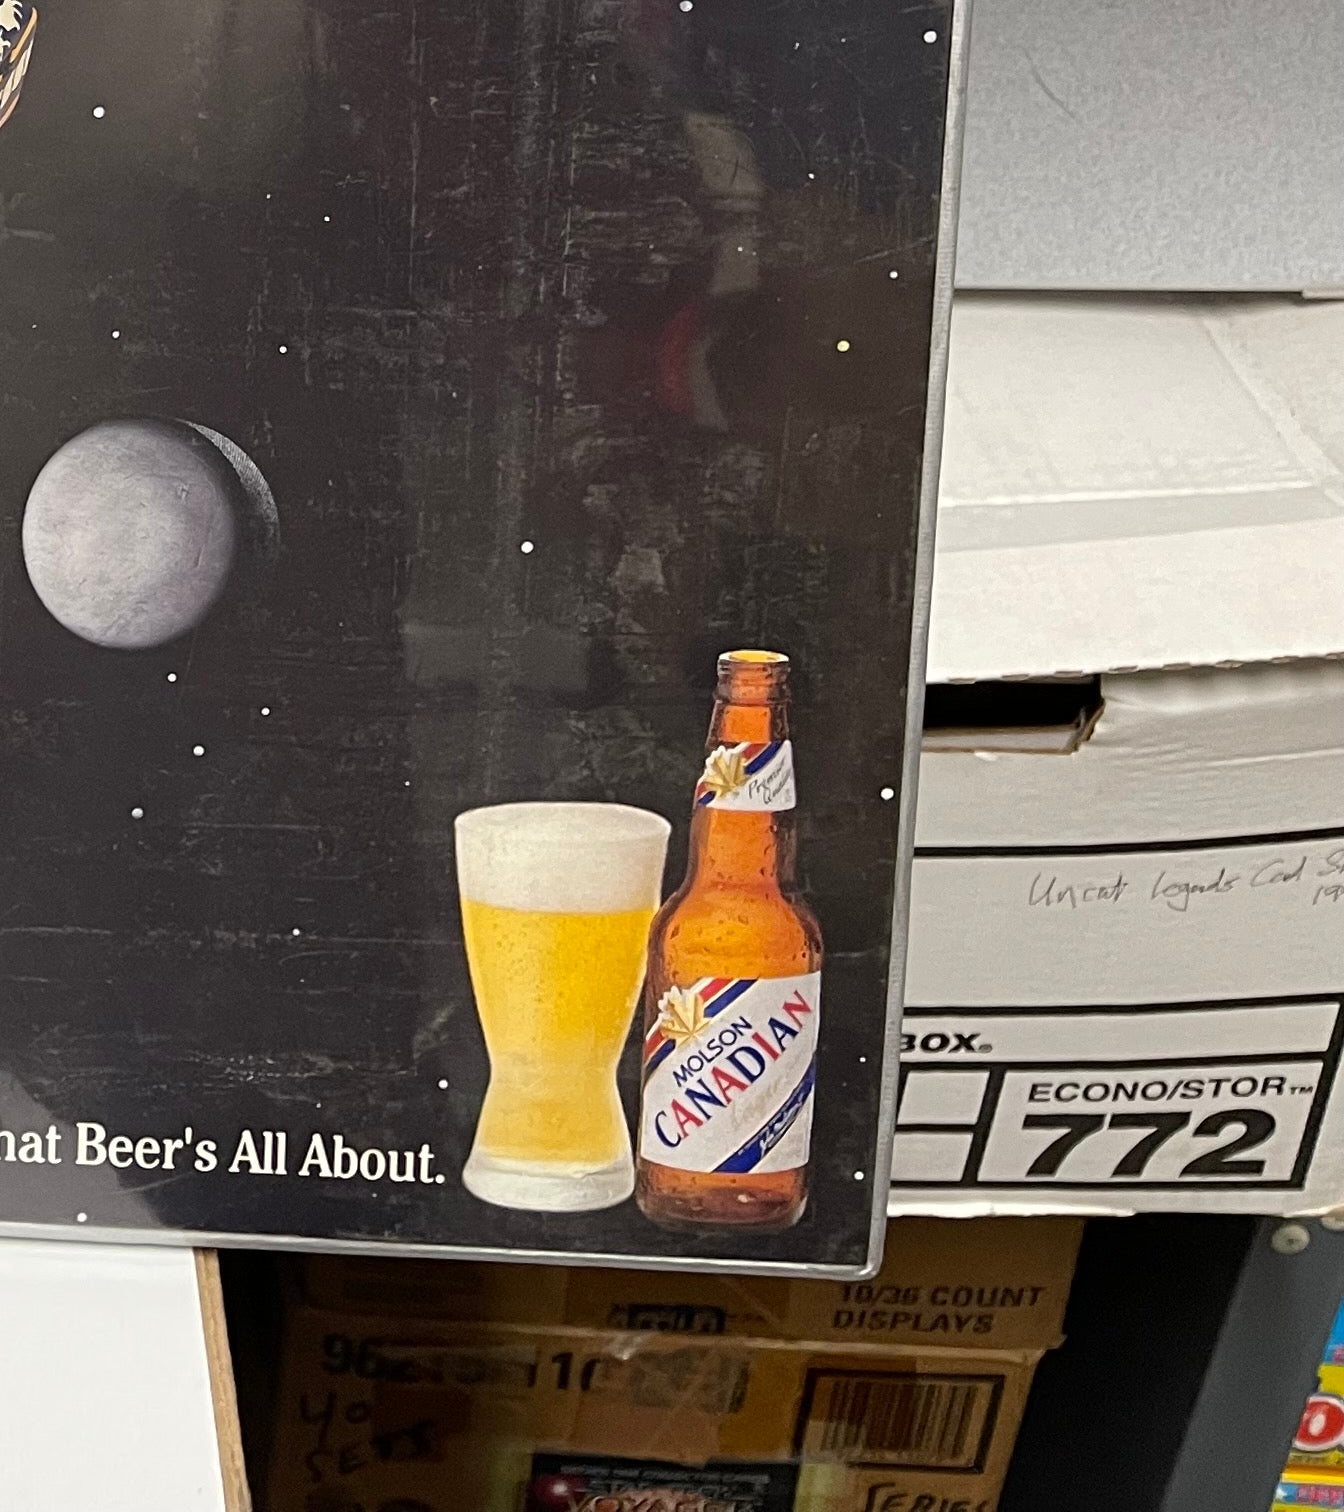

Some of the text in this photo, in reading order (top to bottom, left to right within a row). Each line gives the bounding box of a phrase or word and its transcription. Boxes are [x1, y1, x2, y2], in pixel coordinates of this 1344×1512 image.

[654, 989, 813, 1148] CANADIAN
[672, 1015, 753, 1088] MOLSON
[74, 1119, 217, 1172] Beer's
[227, 1129, 287, 1175] All
[298, 1132, 446, 1185] About.
[1021, 1108, 1277, 1178] 772
[831, 1309, 995, 1333] DISPLAYS
[929, 1285, 1048, 1307] COUNT
